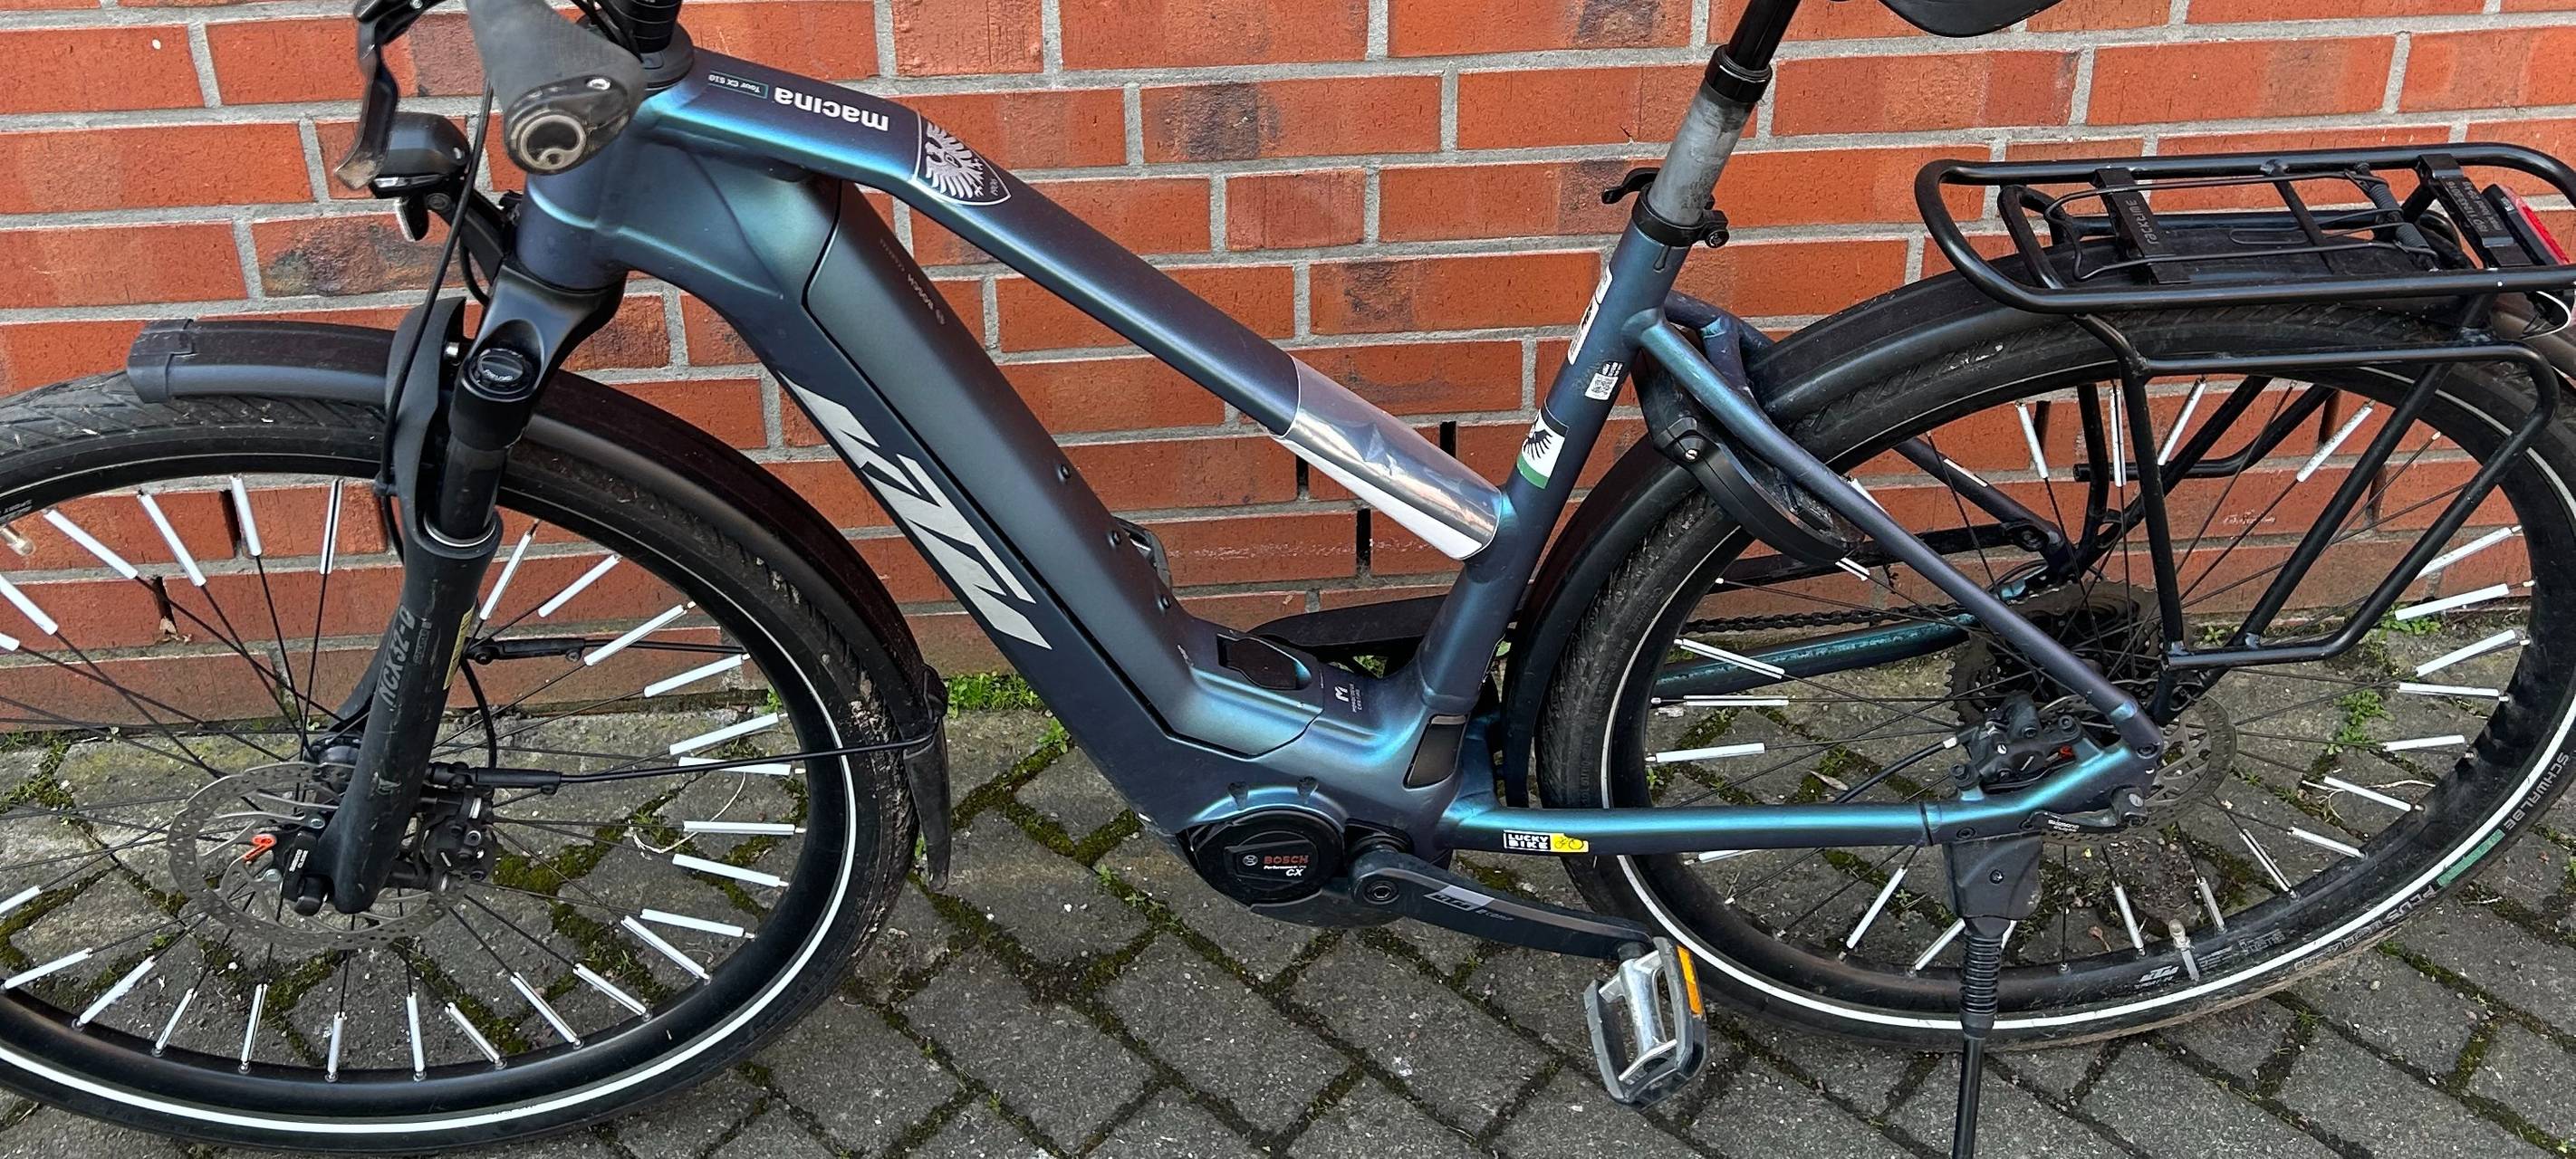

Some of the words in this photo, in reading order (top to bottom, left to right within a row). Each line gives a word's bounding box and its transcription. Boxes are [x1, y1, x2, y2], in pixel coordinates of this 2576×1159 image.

[726, 78, 739, 88] CX
[740, 81, 761, 93] Tour
[774, 87, 889, 131] macina
[2504, 752, 2569, 831] SCHWALBE
[1508, 833, 1549, 842] LUCKY
[1508, 839, 1549, 849] BIKE
[1264, 855, 1309, 864] BOSCH
[2388, 885, 2437, 920] PLUS
